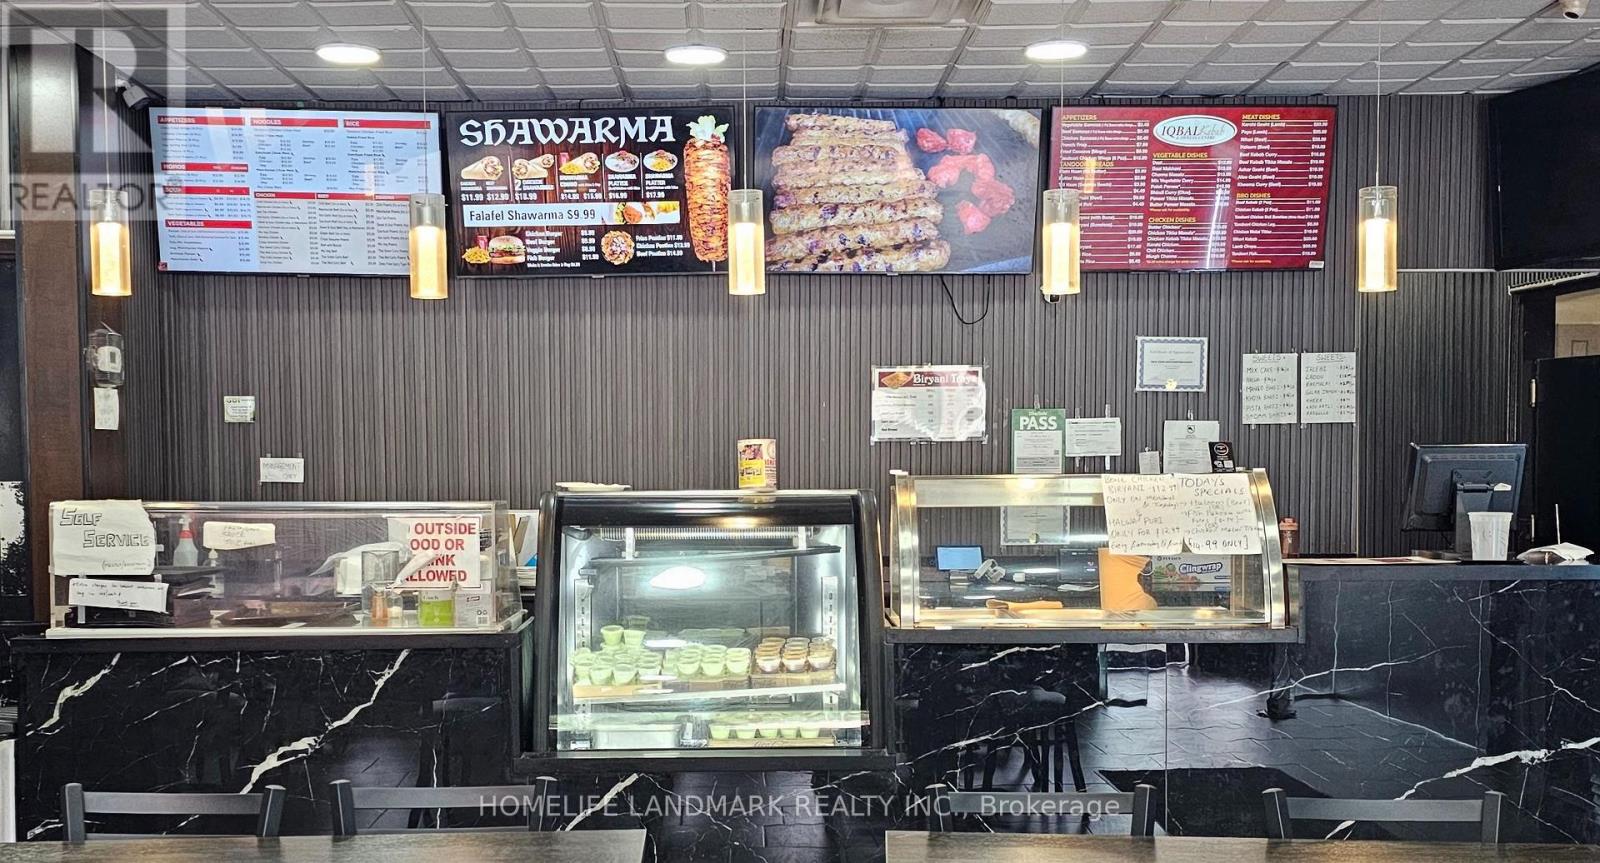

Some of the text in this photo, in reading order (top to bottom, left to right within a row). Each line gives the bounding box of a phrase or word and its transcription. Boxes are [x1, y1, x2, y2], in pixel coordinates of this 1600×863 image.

[459, 116, 676, 148] SHAWARMA
[1161, 125, 1198, 138] IQBAL
[514, 179, 522, 192] 2
[461, 193, 484, 202] $11.99
[486, 192, 510, 202] $12.99
[469, 209, 595, 221] Falafel Shawarma $9.99
[912, 373, 949, 385] Biryani
[1019, 415, 1058, 430] PASS
[59, 507, 104, 526] SELF
[414, 522, 477, 535] OUTSIDE
[83, 529, 150, 549] SERVICE
[410, 538, 465, 551] OOD OR
[1178, 561, 1223, 576] Clingwrap
[405, 569, 468, 582] LLOWED
